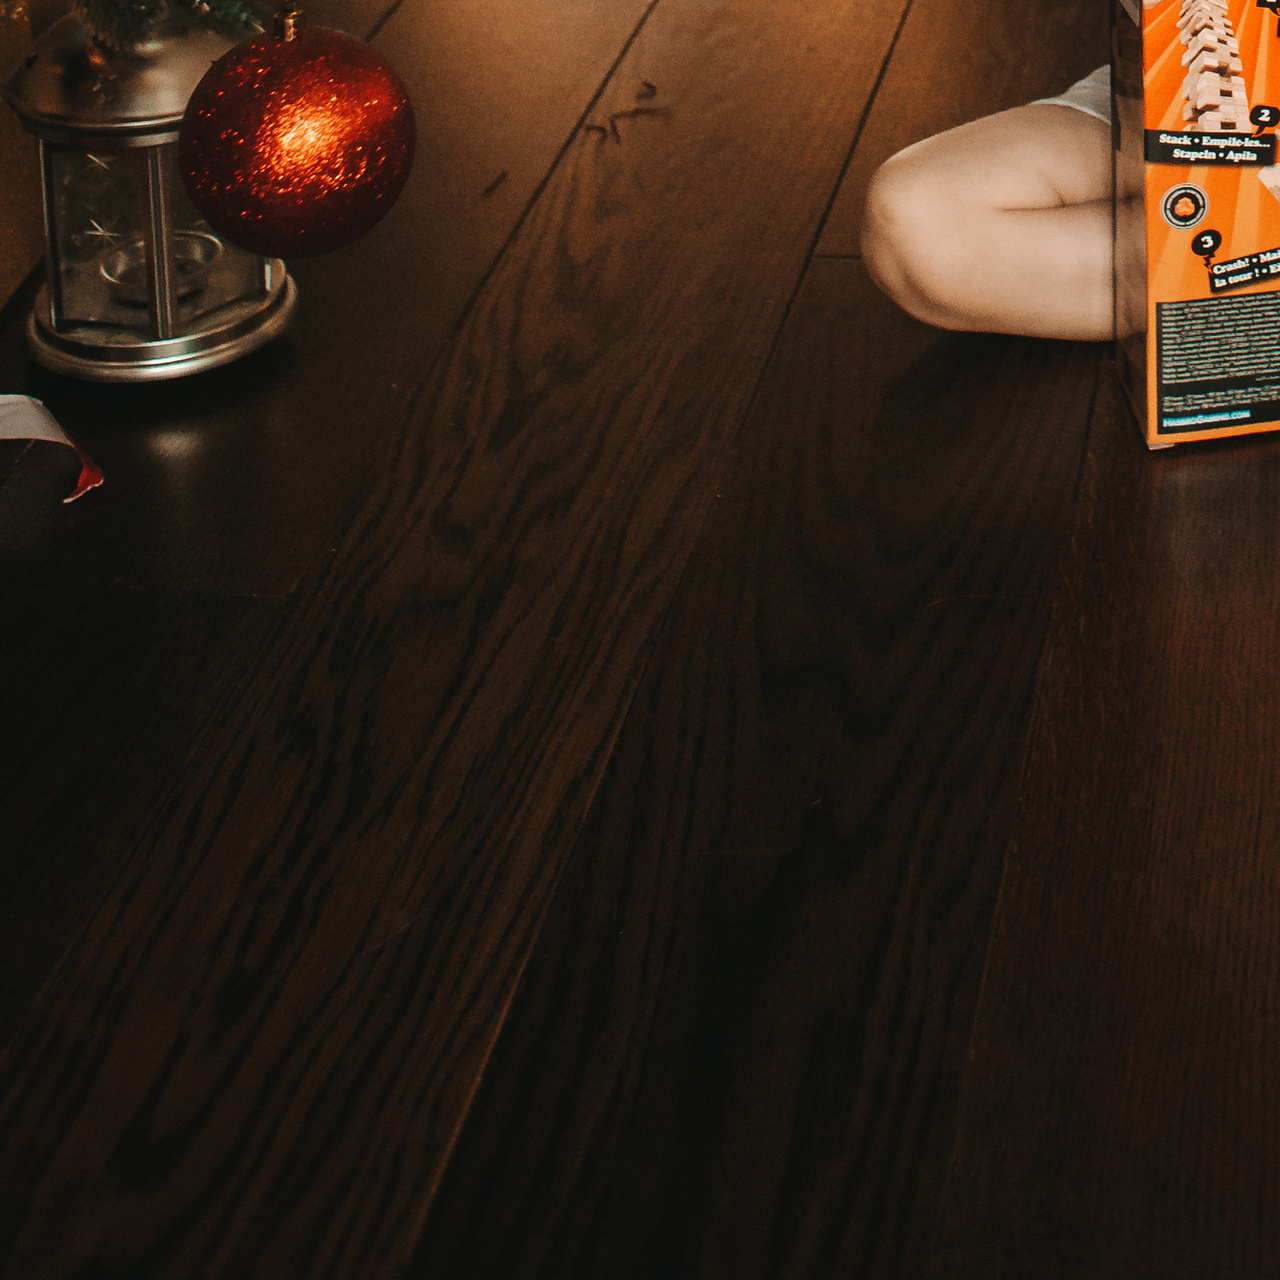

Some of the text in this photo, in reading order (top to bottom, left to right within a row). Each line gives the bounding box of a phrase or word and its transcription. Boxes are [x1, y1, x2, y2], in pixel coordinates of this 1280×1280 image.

[1258, 109, 1271, 122] 2
[1159, 133, 1192, 145] Stack
[1172, 148, 1257, 162] Stapeln Apila
[1201, 235, 1214, 248] 3
[1213, 258, 1250, 275] Crash!
[1214, 277, 1228, 288] la
[1228, 271, 1254, 284] tour
